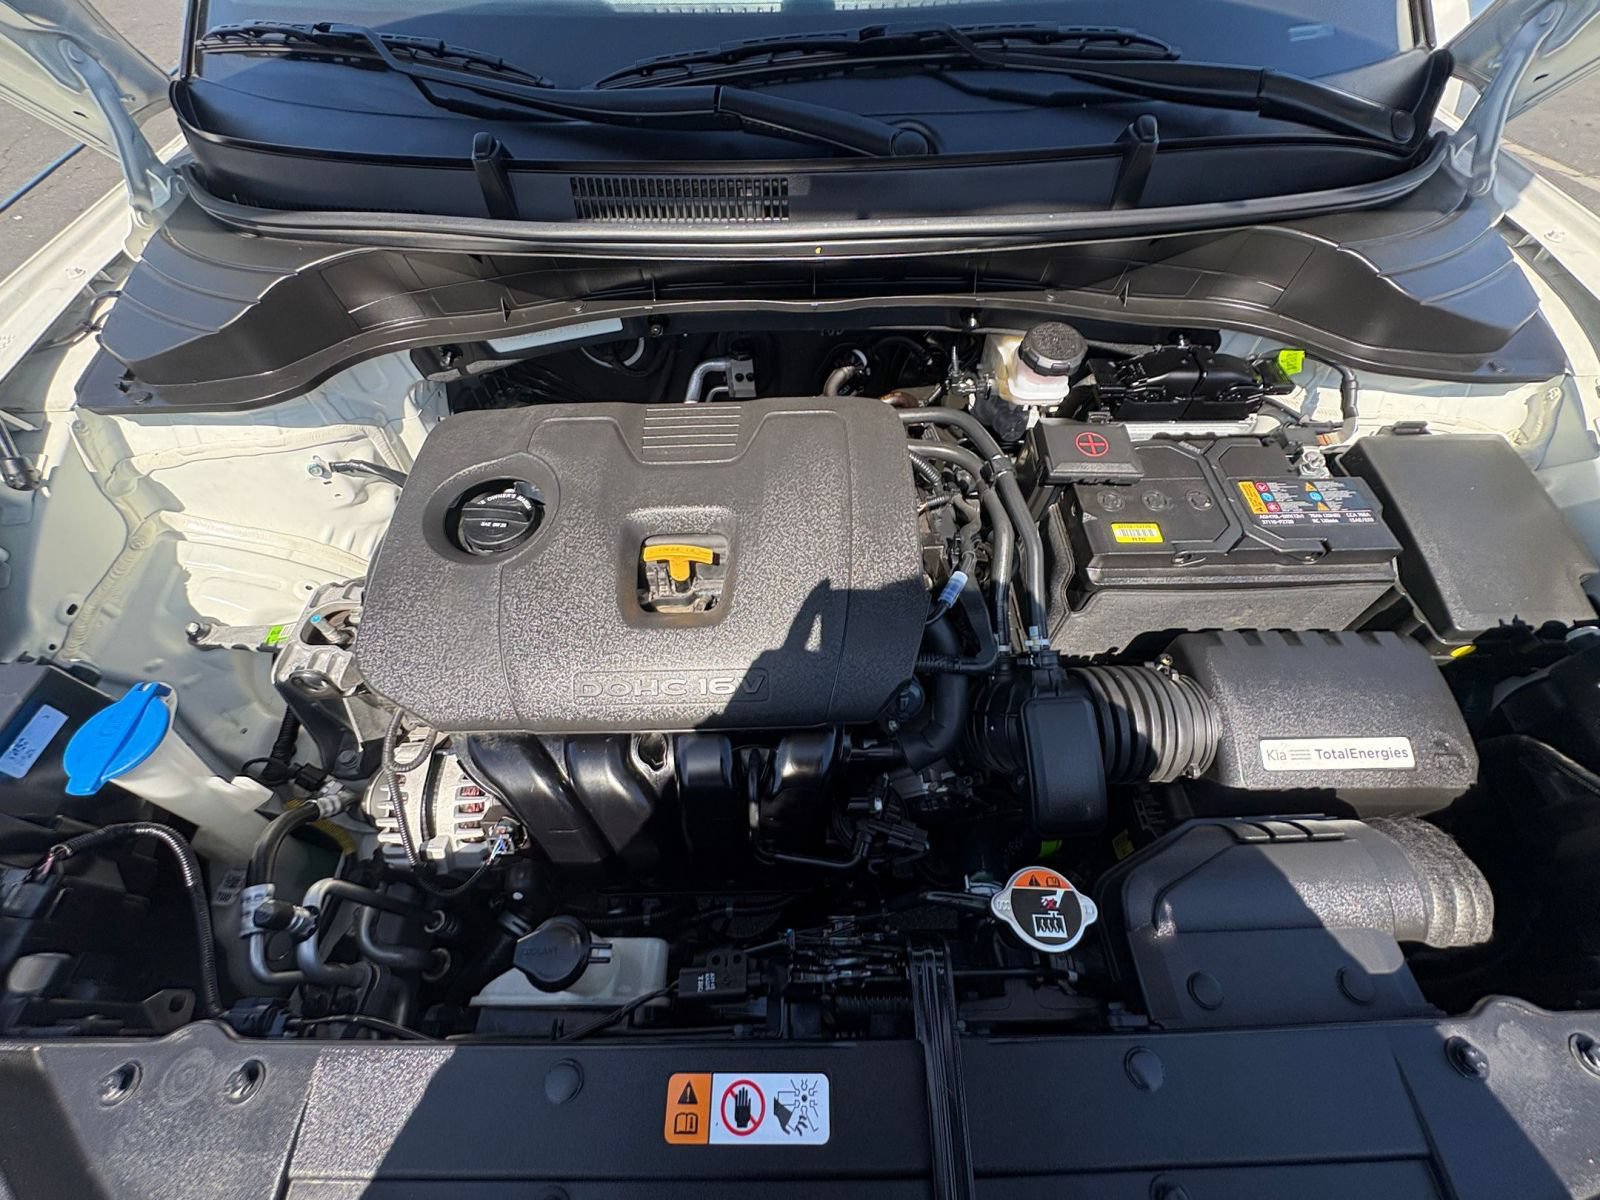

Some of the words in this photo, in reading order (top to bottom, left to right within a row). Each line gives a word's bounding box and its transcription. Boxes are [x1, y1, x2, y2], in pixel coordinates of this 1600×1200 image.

[487, 493, 516, 501] OWNER'S
[576, 678, 688, 697] DOHC
[699, 675, 765, 696] 16V
[1266, 748, 1288, 761] Kia
[1314, 747, 1409, 761] TotalEnergies
